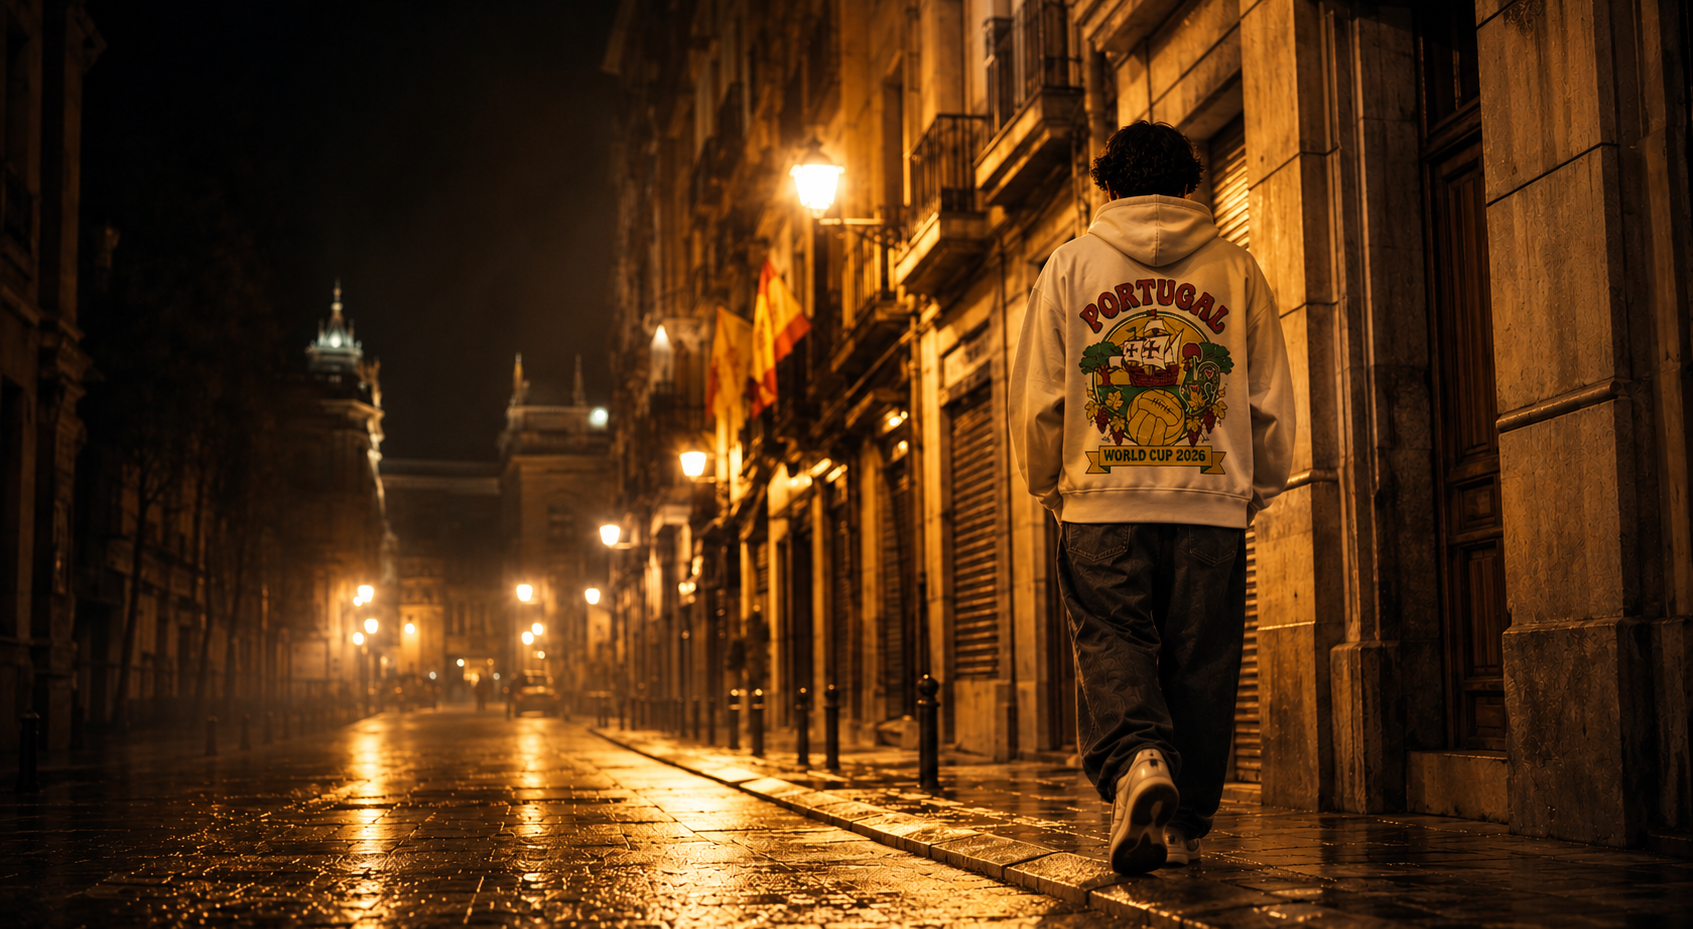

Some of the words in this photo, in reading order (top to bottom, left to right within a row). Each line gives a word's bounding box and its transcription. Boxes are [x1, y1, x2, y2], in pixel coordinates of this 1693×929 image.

[1079, 279, 1229, 334] PORTUGAL
[1104, 449, 1146, 462] WORLD
[1149, 449, 1173, 462] CUP
[1176, 449, 1206, 462] 2026
